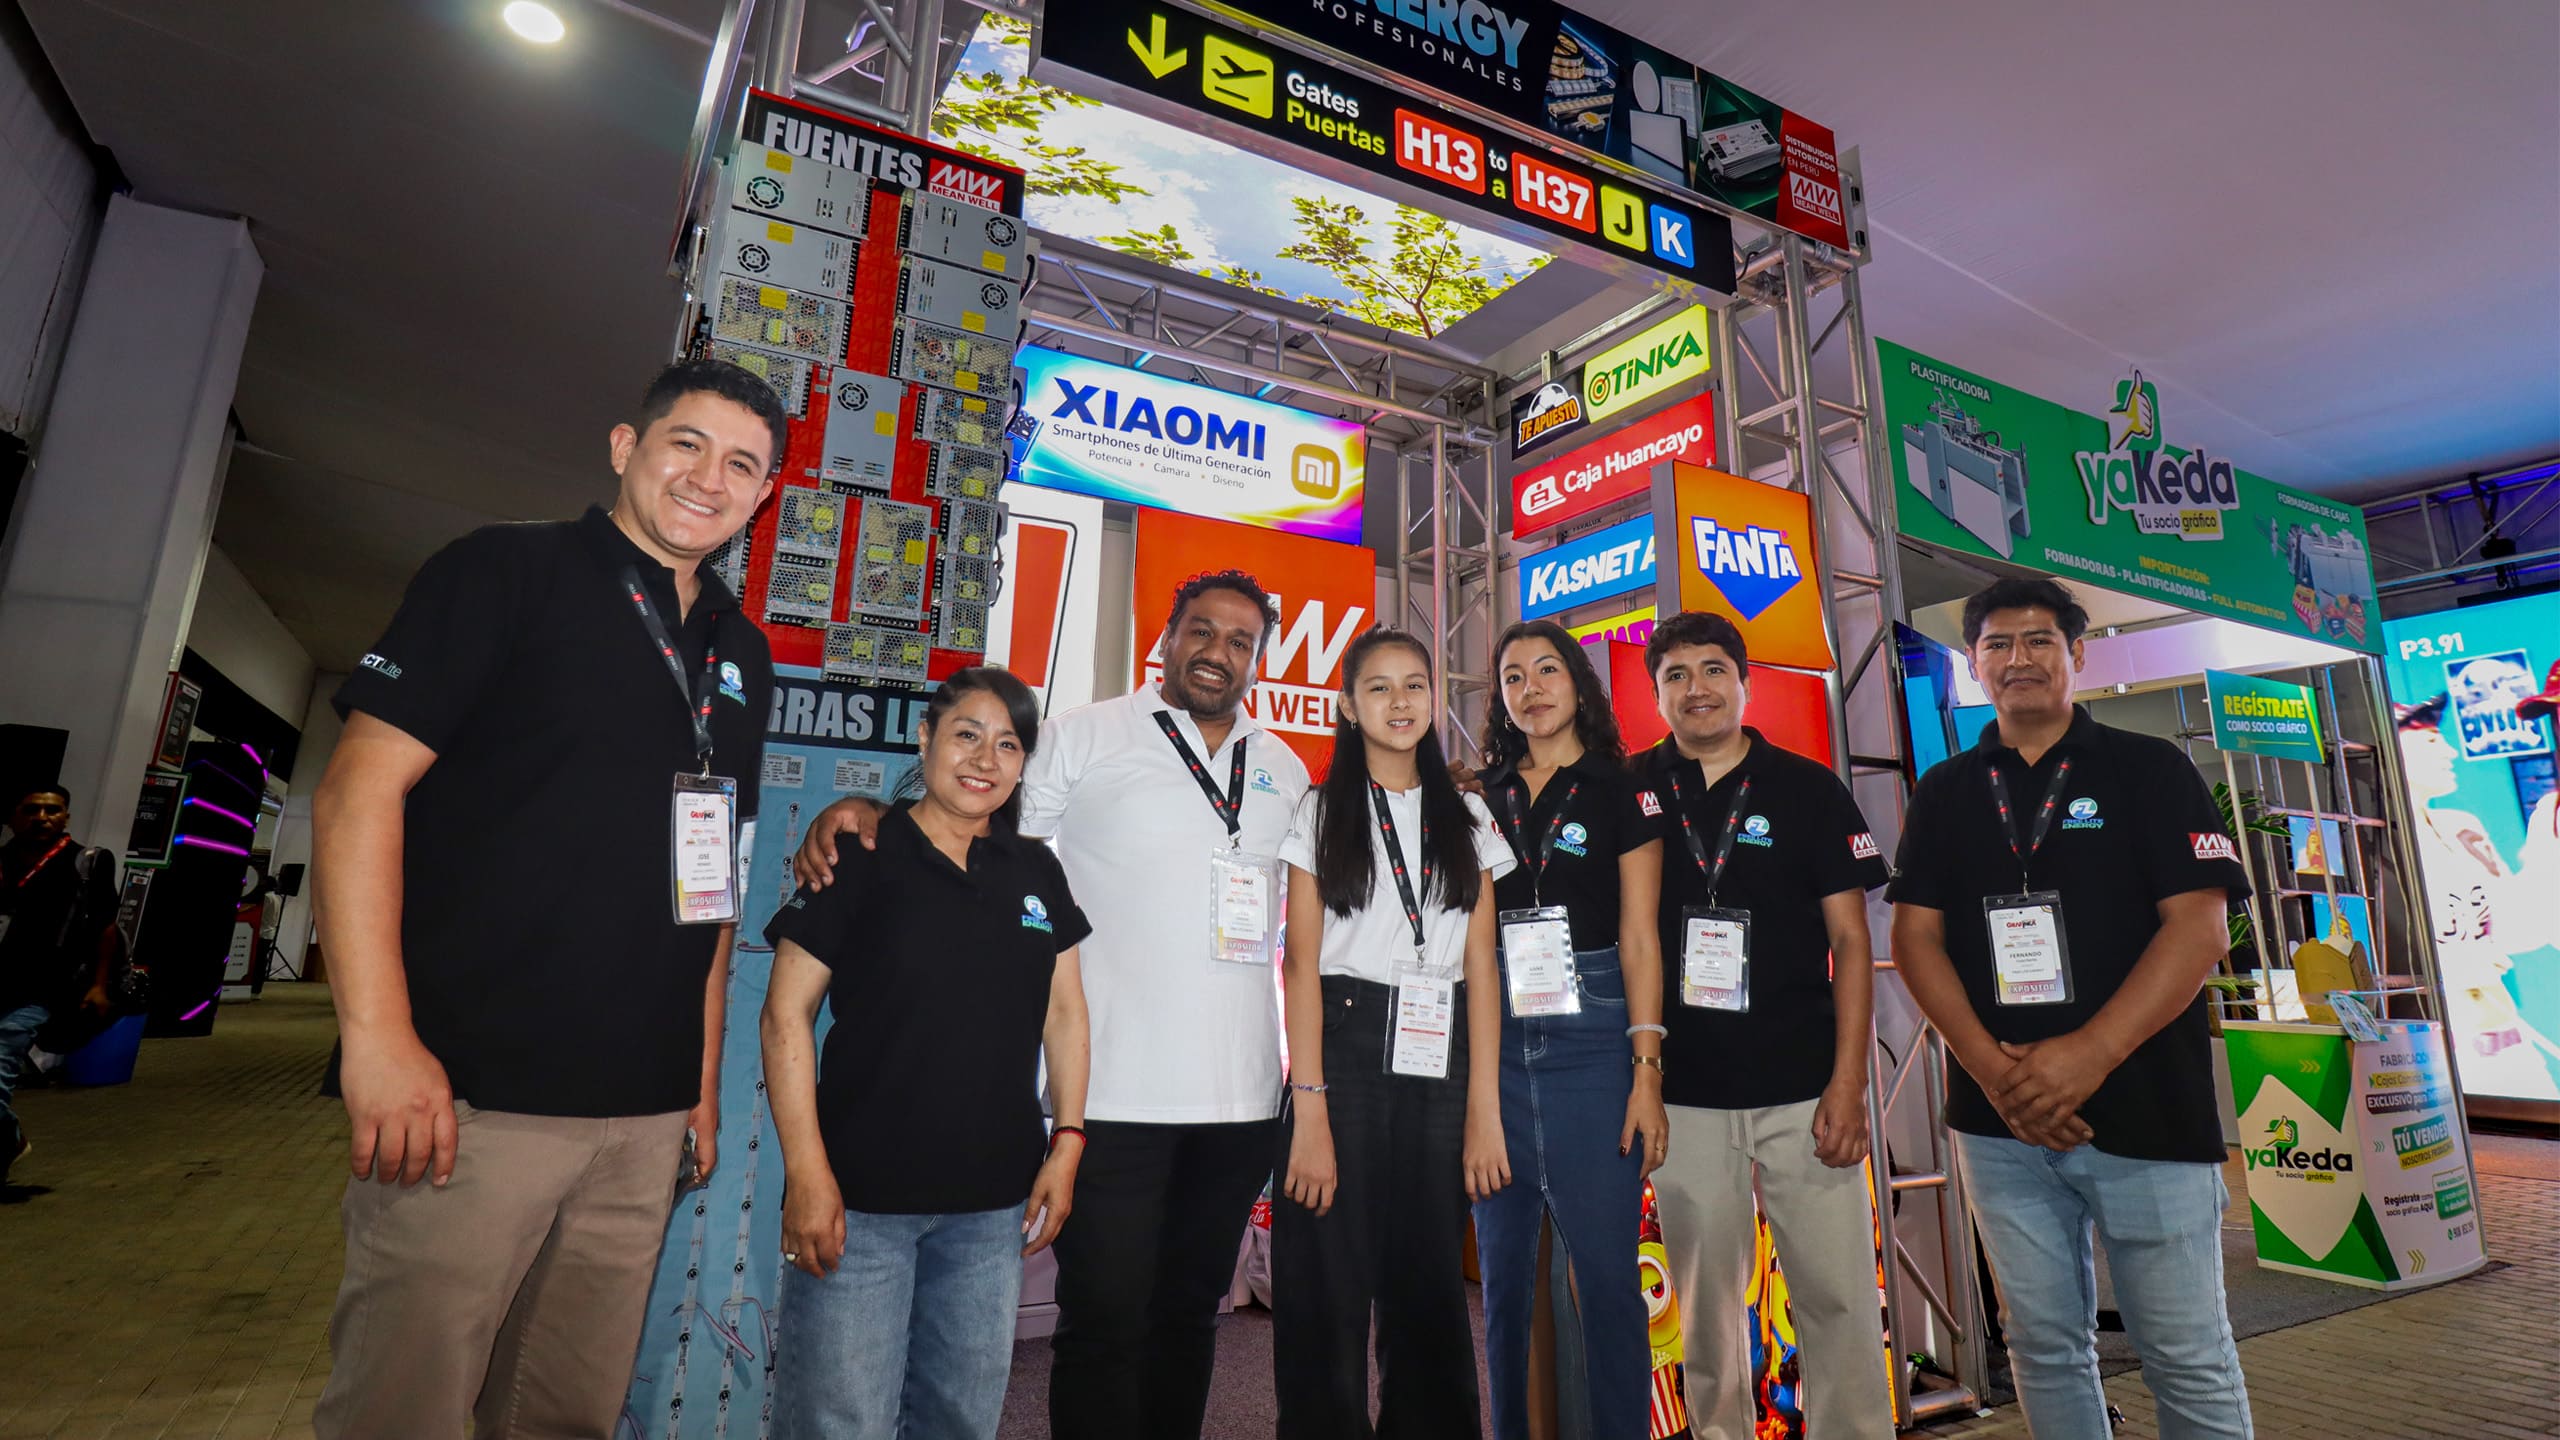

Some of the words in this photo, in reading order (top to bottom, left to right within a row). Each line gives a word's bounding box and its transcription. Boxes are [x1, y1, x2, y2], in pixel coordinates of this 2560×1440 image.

[1350, 0, 1529, 69] ERGY
[1286, 72, 1360, 119] Gates
[1287, 99, 1386, 156] Puertas
[764, 112, 923, 189] FUENTES
[1402, 120, 1478, 182] H13
[1489, 149, 1507, 172] to
[1785, 134, 1835, 162] DISTRIBUIDOR
[1786, 145, 1836, 173] AUTORIZADO
[1787, 156, 1798, 168] EN
[931, 164, 1002, 198] MW
[1492, 179, 1506, 200] a
[1519, 164, 1590, 220] H37
[1794, 178, 1836, 207] MW
[932, 186, 966, 203] MEAN
[968, 194, 1000, 211] WELL
[1795, 197, 1817, 214] MEAN
[1818, 204, 1838, 222] WELL
[1613, 204, 1632, 236] J
[1659, 216, 1687, 258] K
[1910, 362, 1991, 402] PLASTIFICADORA
[1050, 376, 1266, 461] XIAOMI
[1520, 420, 1533, 443] TE
[1533, 399, 1578, 436] APUESTO
[1053, 424, 1141, 453] Smartphones
[1143, 443, 1160, 457] de
[1162, 444, 1202, 465] Última
[1205, 455, 1271, 480] Generación
[1088, 449, 1132, 467] Potencia
[1564, 463, 1601, 492] Caja
[1605, 424, 1703, 477] Huancayo
[2081, 449, 2236, 519] yaKeda
[2139, 513, 2152, 528] Tu
[2154, 512, 2180, 528] socio
[2182, 513, 2217, 532] gráfico
[1692, 518, 1800, 580] FANTA
[1528, 539, 1641, 606] KASNET
[2044, 548, 2116, 579] FORMADORAS
[2122, 569, 2207, 602] PLASTIFICADORAS
[2212, 593, 2233, 608] FULL
[2400, 633, 2464, 660] P3.91
[2223, 690, 2306, 718] REGÍSTRATE
[2226, 720, 2250, 732] COMO
[2251, 721, 2275, 733] SOCIO
[2275, 720, 2307, 734] GRÁFICO
[2010, 951, 2042, 959] FERNANDO
[2367, 1094, 2413, 1108] EXCLUSIVO
[2394, 1128, 2411, 1151] TÚ
[2413, 1121, 2449, 1147] VENDES
[2244, 1147, 2353, 1171] yaKeda
[2276, 1170, 2284, 1178] Tu
[2286, 1171, 2304, 1179] socio
[2386, 1207, 2401, 1216] socio
